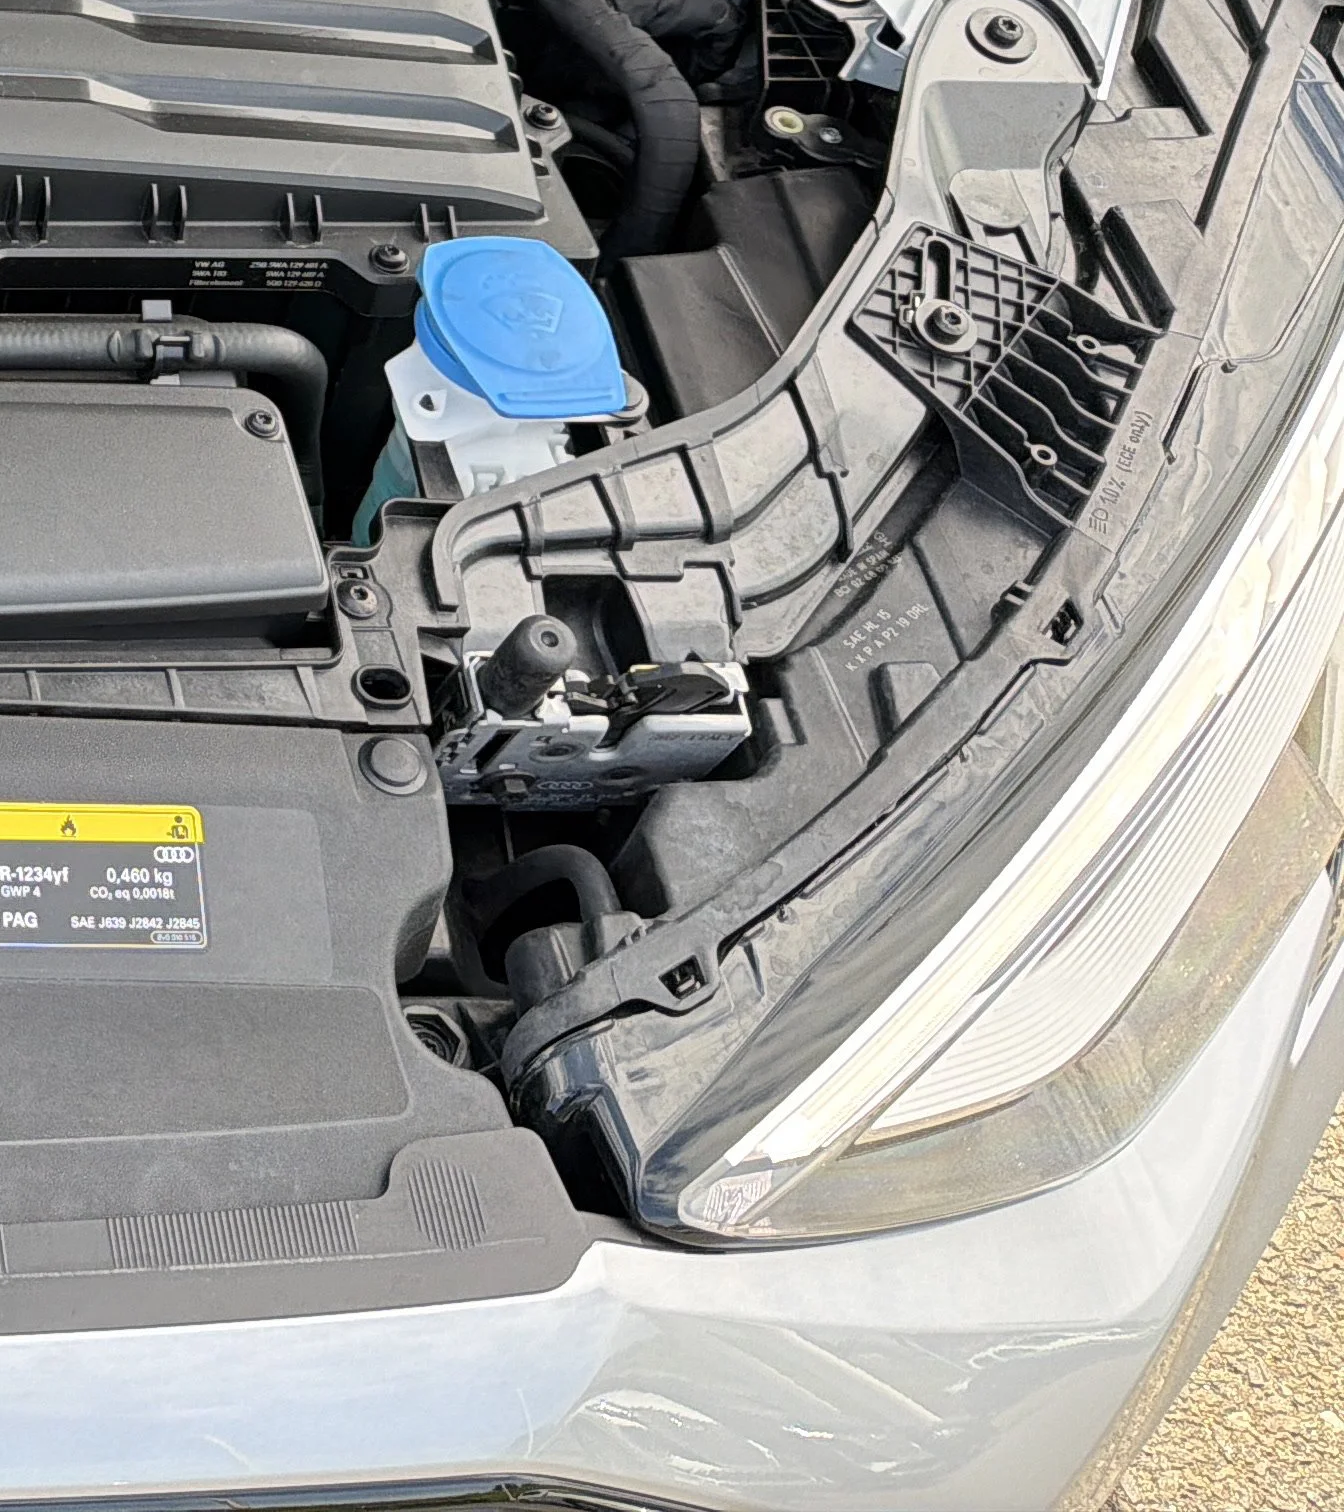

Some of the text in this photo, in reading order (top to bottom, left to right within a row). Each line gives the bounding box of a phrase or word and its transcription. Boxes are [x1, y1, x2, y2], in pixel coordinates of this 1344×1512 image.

[842, 608, 892, 649] SAE HL 15
[873, 638, 886, 649] A
[881, 626, 900, 641] P2
[895, 616, 911, 629] 19
[906, 603, 930, 620] DRL
[106, 867, 150, 884] 0,460
[153, 868, 173, 887] kg
[0, 885, 30, 898] GWP
[32, 886, 41, 898] 4
[115, 890, 131, 902] eq
[2, 911, 201, 930] PAG SAE J639 J2842 J2845
